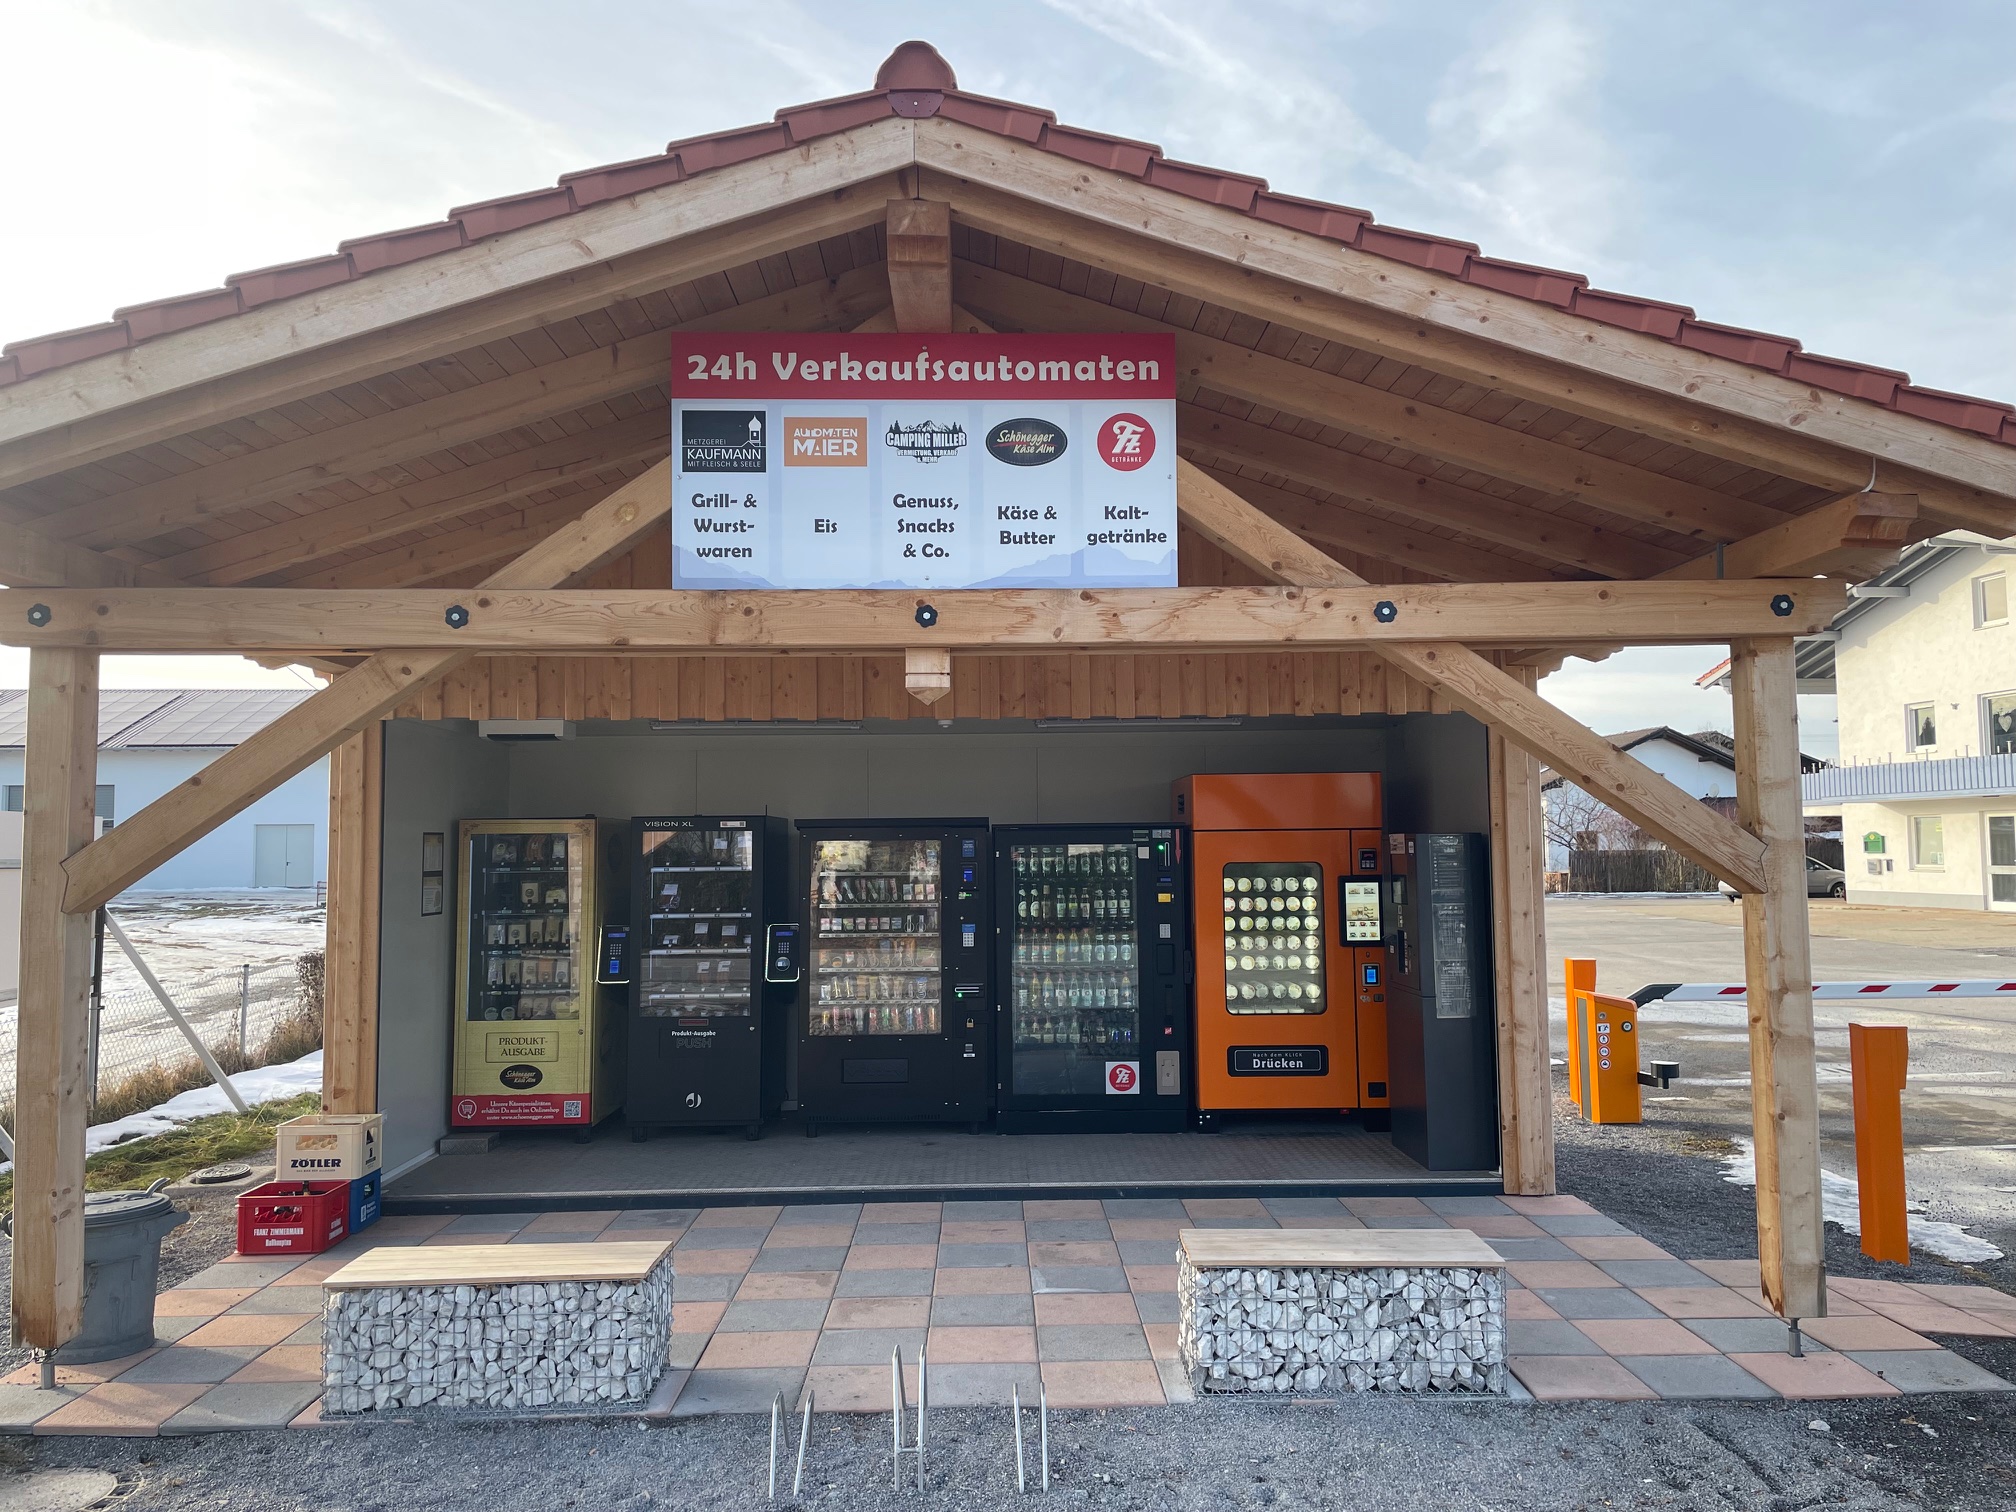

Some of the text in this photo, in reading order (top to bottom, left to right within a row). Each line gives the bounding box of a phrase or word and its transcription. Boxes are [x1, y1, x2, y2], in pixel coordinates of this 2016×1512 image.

[687, 351, 1160, 382] 24h Verkaufsautomaten
[793, 428, 858, 437] AUTOMATEN
[886, 432, 966, 448] CAMPING MILLER
[996, 430, 1055, 446] Schönegger
[687, 448, 761, 460] KAUFMANN
[793, 439, 858, 456] MAIER
[1012, 444, 1055, 454] Käse Alm
[691, 493, 757, 508] Grill- &
[893, 493, 959, 510] Genuss,
[997, 505, 1057, 520] Käse &
[1104, 505, 1149, 520] Kalt-
[694, 518, 755, 533] Wurst-
[814, 518, 838, 533] Eis
[897, 518, 955, 533] Snacks
[1000, 530, 1056, 545] Butter
[1086, 529, 1167, 546] getränke
[696, 547, 752, 558] waren
[903, 543, 950, 558] & Co.
[499, 1037, 548, 1045] PRODUKT-
[671, 1030, 716, 1038] Produkt-Ausgabe
[676, 1038, 712, 1048] PUSH
[501, 1048, 546, 1056] AUSGABE
[1253, 1058, 1303, 1068] Drücken
[291, 1158, 342, 1168] ZÖTLER
[253, 1228, 268, 1236] FRANZ
